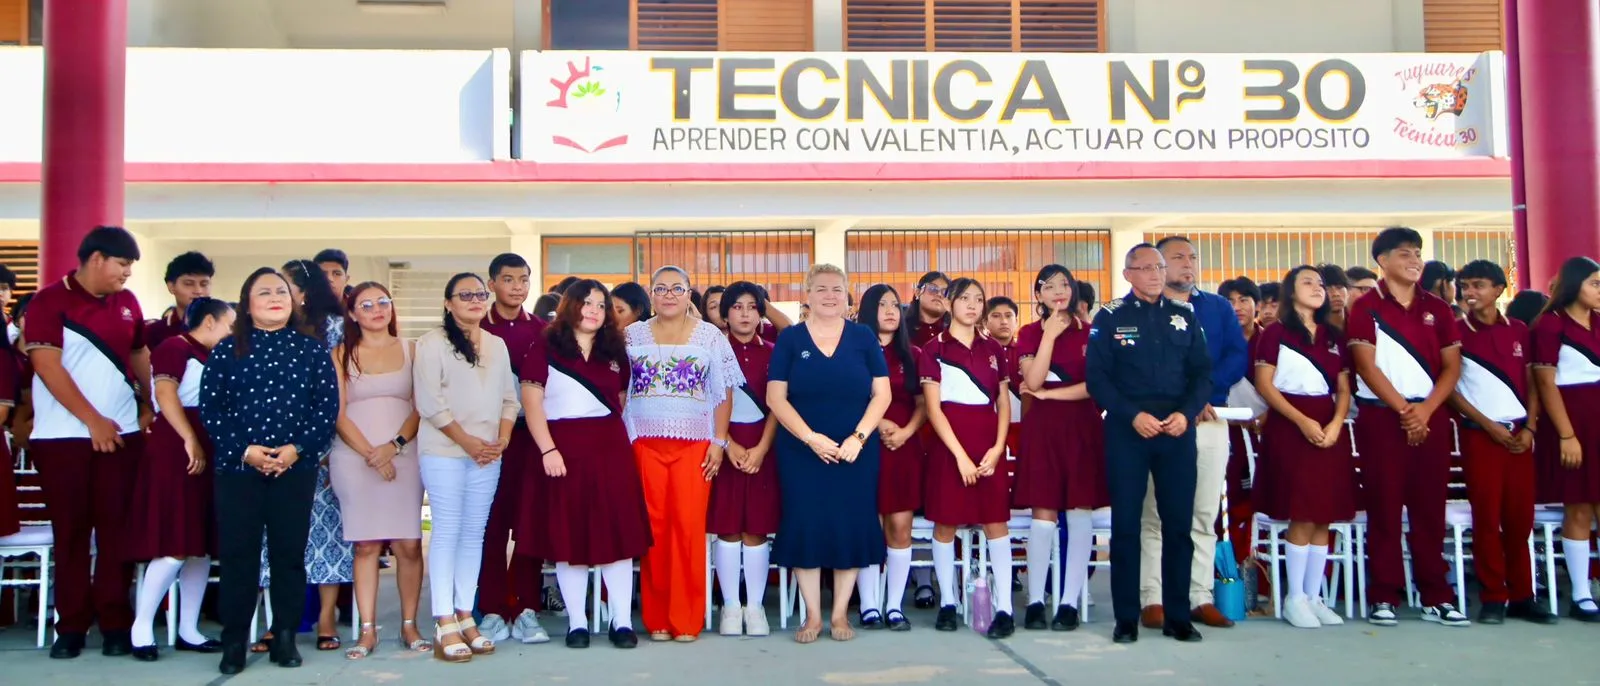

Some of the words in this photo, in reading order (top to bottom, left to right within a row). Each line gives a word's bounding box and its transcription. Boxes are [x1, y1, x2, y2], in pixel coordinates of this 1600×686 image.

[649, 57, 1071, 124] TECNICA
[1243, 58, 1367, 124] 30
[652, 127, 787, 151] APRENDER
[796, 127, 850, 151] CON
[860, 128, 1020, 156] VALENTIA,
[1025, 128, 1144, 150] ACTUAR
[1153, 128, 1216, 151] CON
[1228, 127, 1370, 149] PROPOSITO
[1459, 127, 1477, 144] 30
